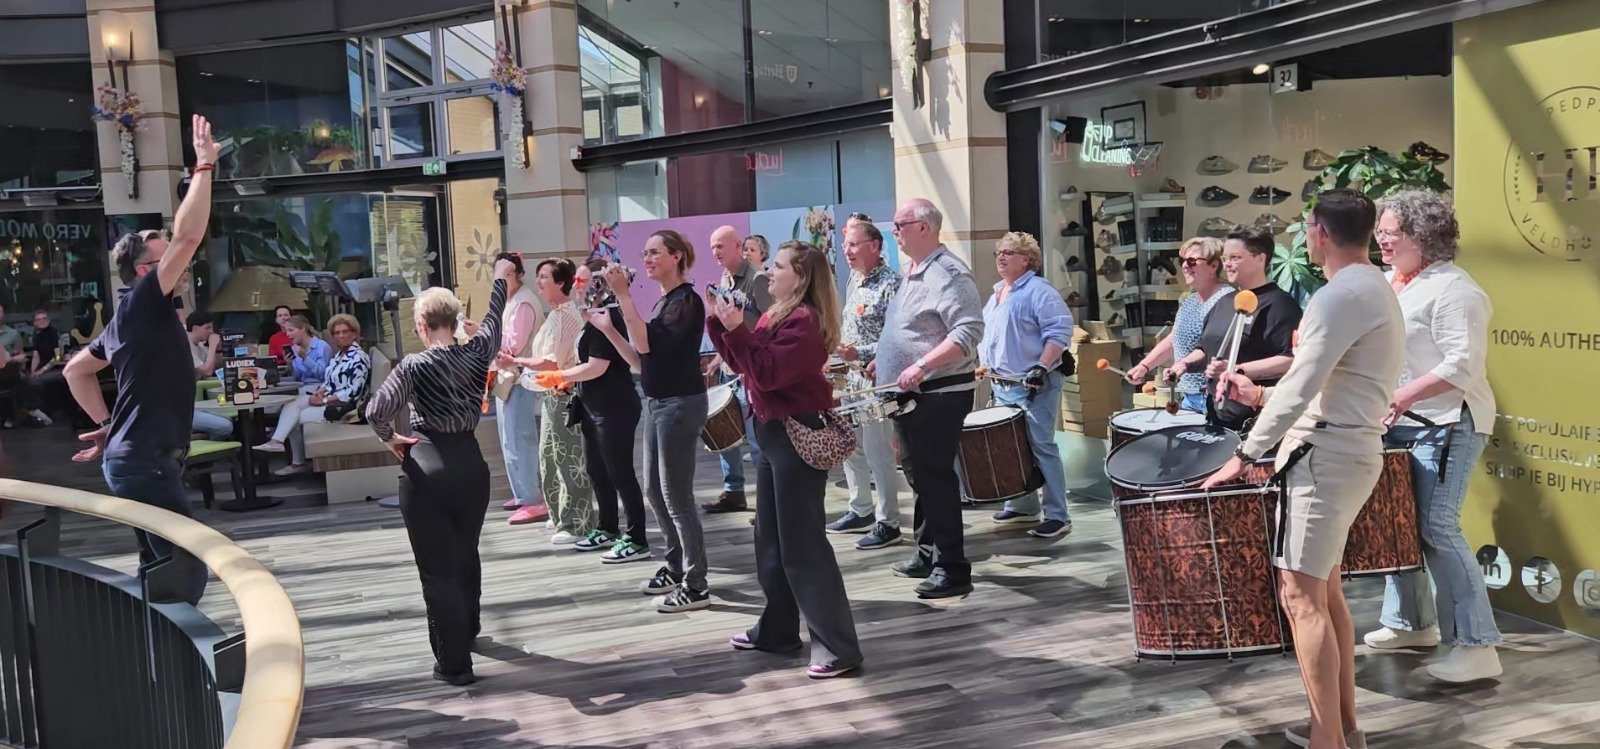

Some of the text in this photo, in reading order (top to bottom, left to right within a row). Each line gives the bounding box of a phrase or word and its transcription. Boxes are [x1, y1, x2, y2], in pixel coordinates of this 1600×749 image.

[1280, 69, 1292, 87] 32
[1091, 145, 1132, 165] CLEANING
[1492, 329, 1535, 348] 100%
[226, 360, 255, 368] LUDIEK
[1529, 469, 1542, 485] JE
[1547, 472, 1565, 492] BIJ
